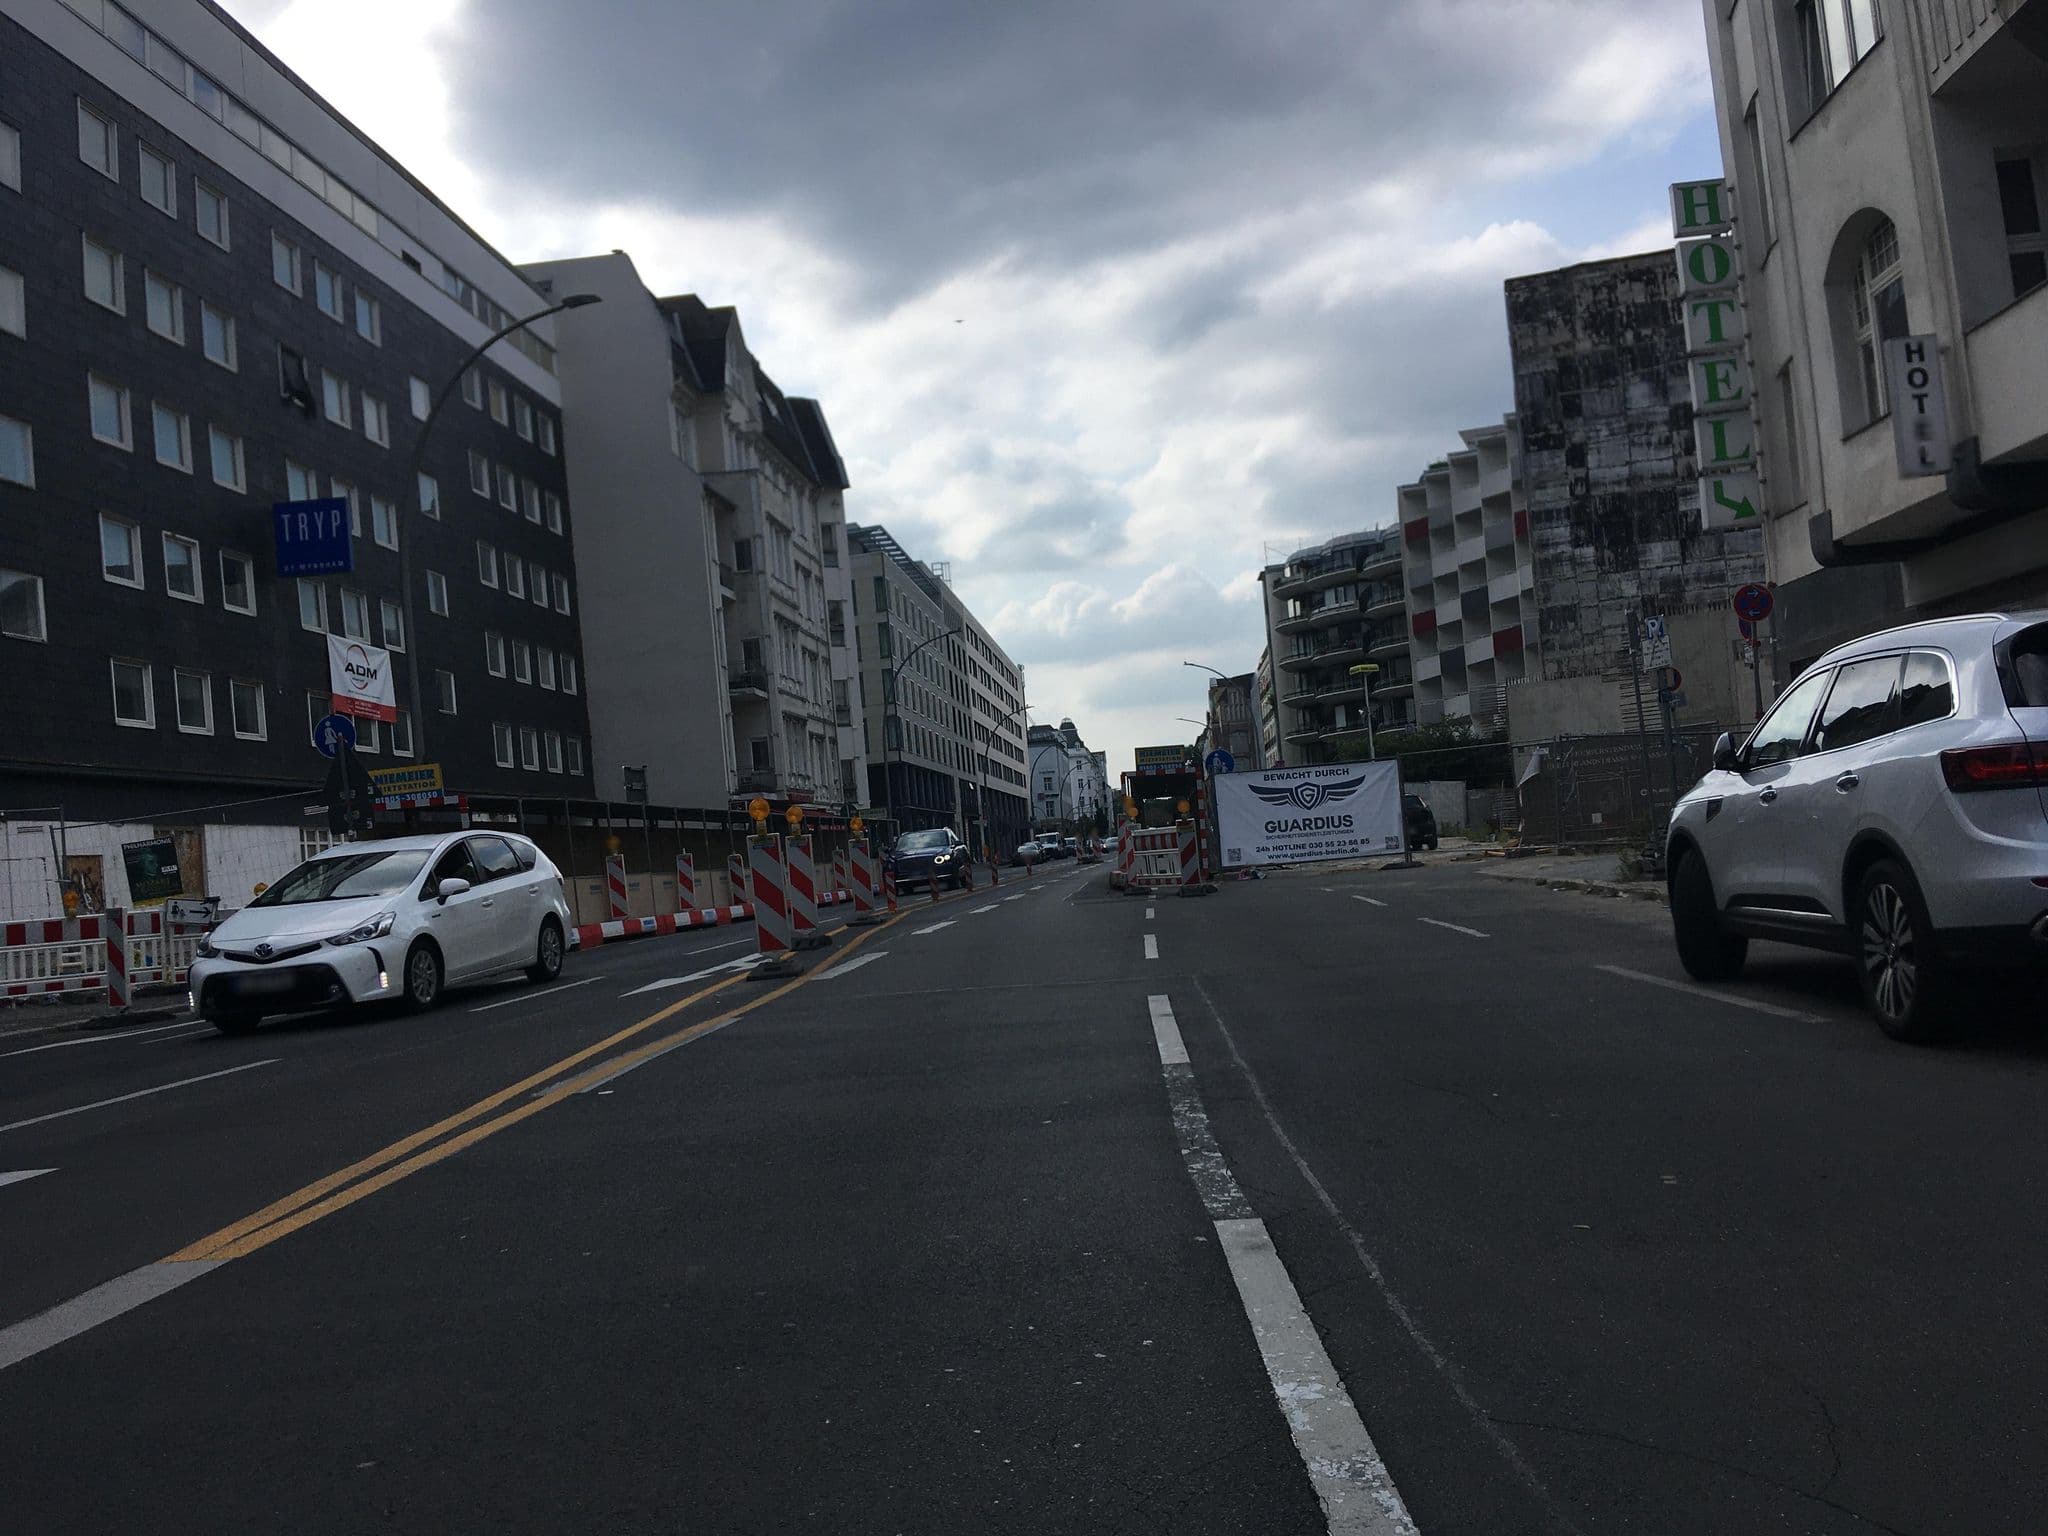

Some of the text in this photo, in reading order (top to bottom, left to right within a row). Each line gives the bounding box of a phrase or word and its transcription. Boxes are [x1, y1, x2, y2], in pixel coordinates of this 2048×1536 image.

[1678, 183, 1750, 462] HOTEL
[280, 510, 341, 543] TRYP
[345, 662, 377, 680] ADM
[1263, 768, 1350, 782] BEWACHT DURCH
[1264, 815, 1354, 834] GUARDIUS
[1255, 845, 1271, 853] 24h
[1272, 842, 1307, 852] HOTLINE
[1309, 842, 1322, 850] 030
[1267, 847, 1360, 860] www.guardius-berlin.de
